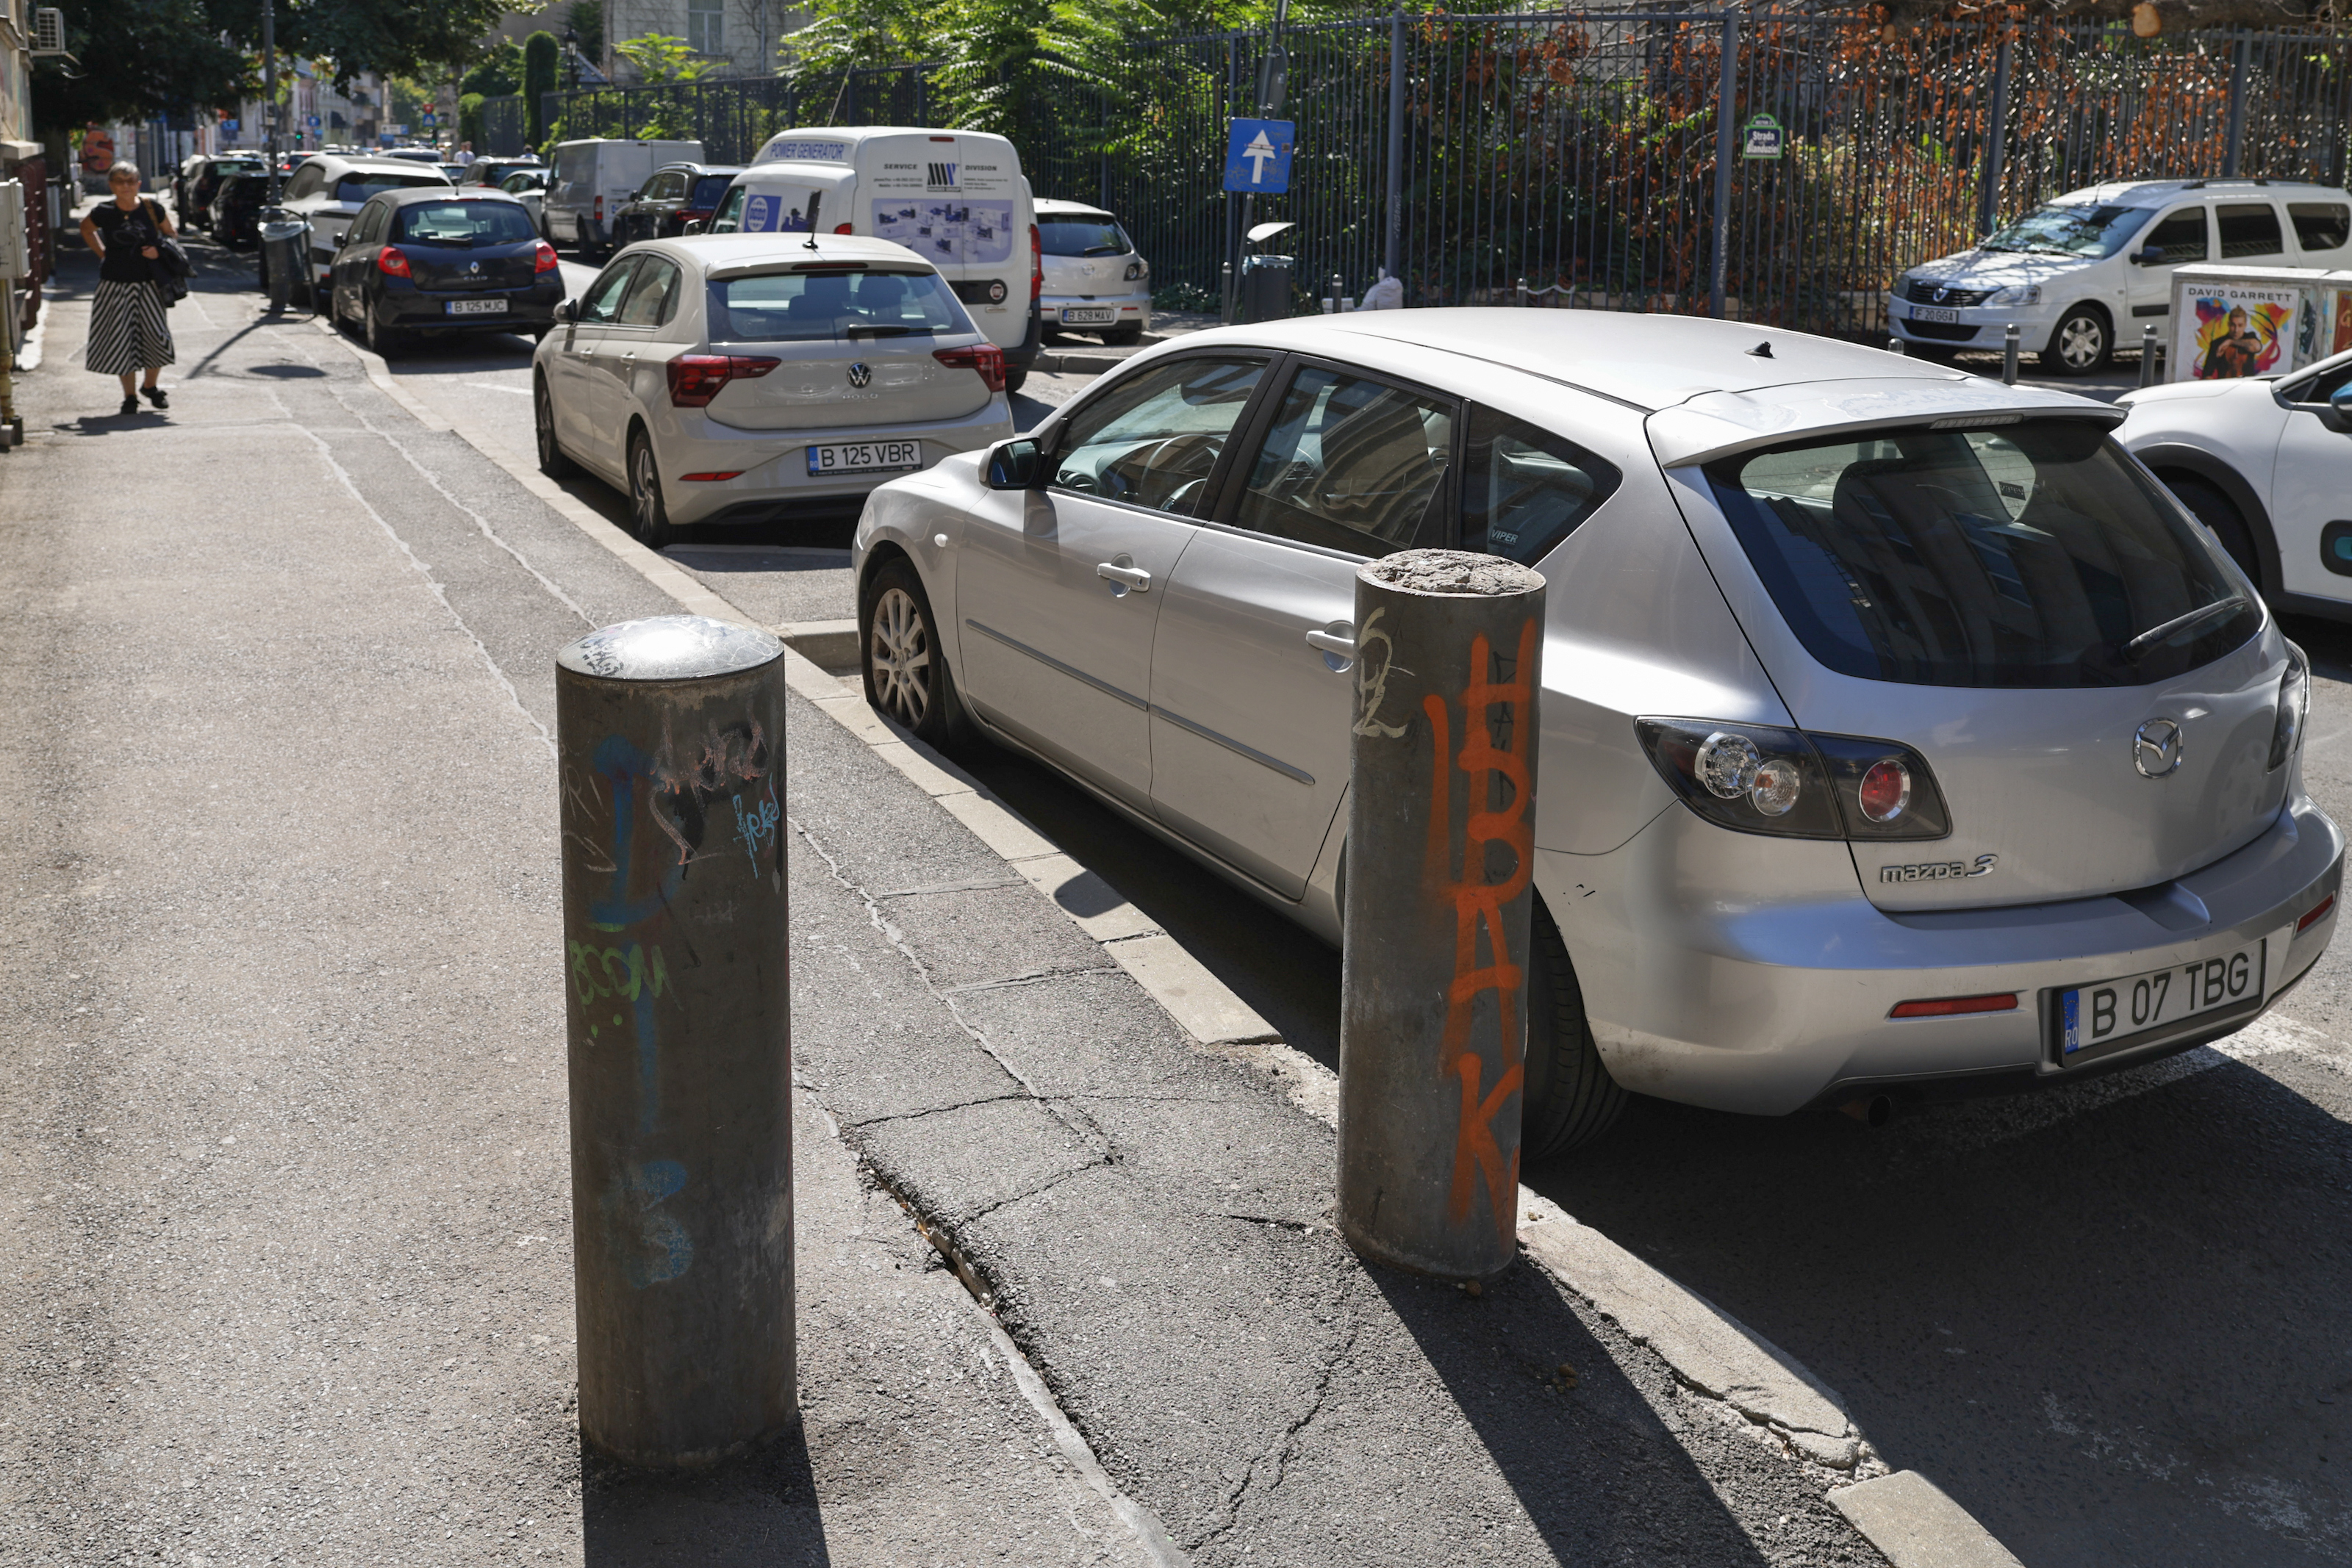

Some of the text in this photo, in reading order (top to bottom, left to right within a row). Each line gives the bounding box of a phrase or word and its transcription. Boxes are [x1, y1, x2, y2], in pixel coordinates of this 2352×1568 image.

[1752, 131, 1775, 141] Strada
[770, 143, 845, 160] POWER GENERATOR
[2188, 287, 2292, 302] DAVID GARRETT
[455, 302, 462, 312] B
[466, 301, 482, 312] 125
[1069, 311, 1111, 321] B 628 MAV
[821, 443, 915, 468] B 125 VBR
[1491, 529, 1519, 543] VIPER
[2092, 952, 2249, 1039] B 07 TBG
[2065, 1026, 2079, 1049] RO
